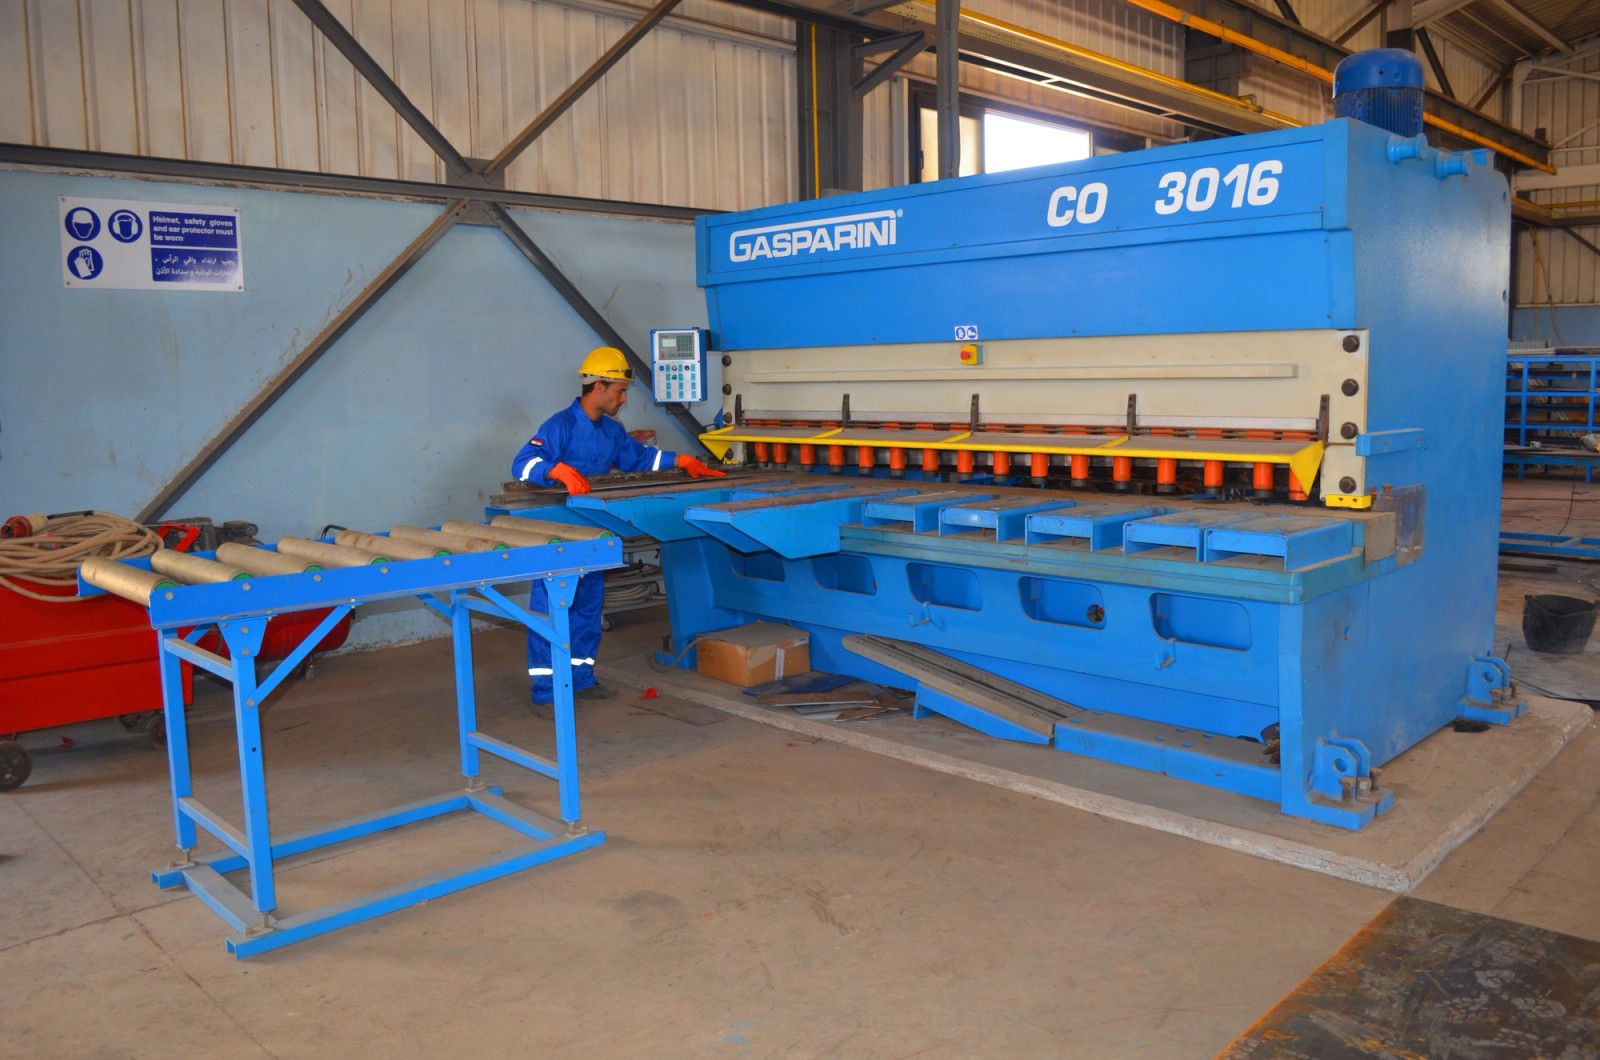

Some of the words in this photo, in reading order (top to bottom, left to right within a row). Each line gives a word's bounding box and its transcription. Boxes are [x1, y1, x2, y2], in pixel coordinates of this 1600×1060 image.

[1047, 182, 1108, 228] CO
[1154, 159, 1283, 215] 3016
[152, 215, 181, 225] Helmet,
[184, 218, 206, 227] safety
[209, 219, 233, 227] gloves
[154, 233, 164, 241] be
